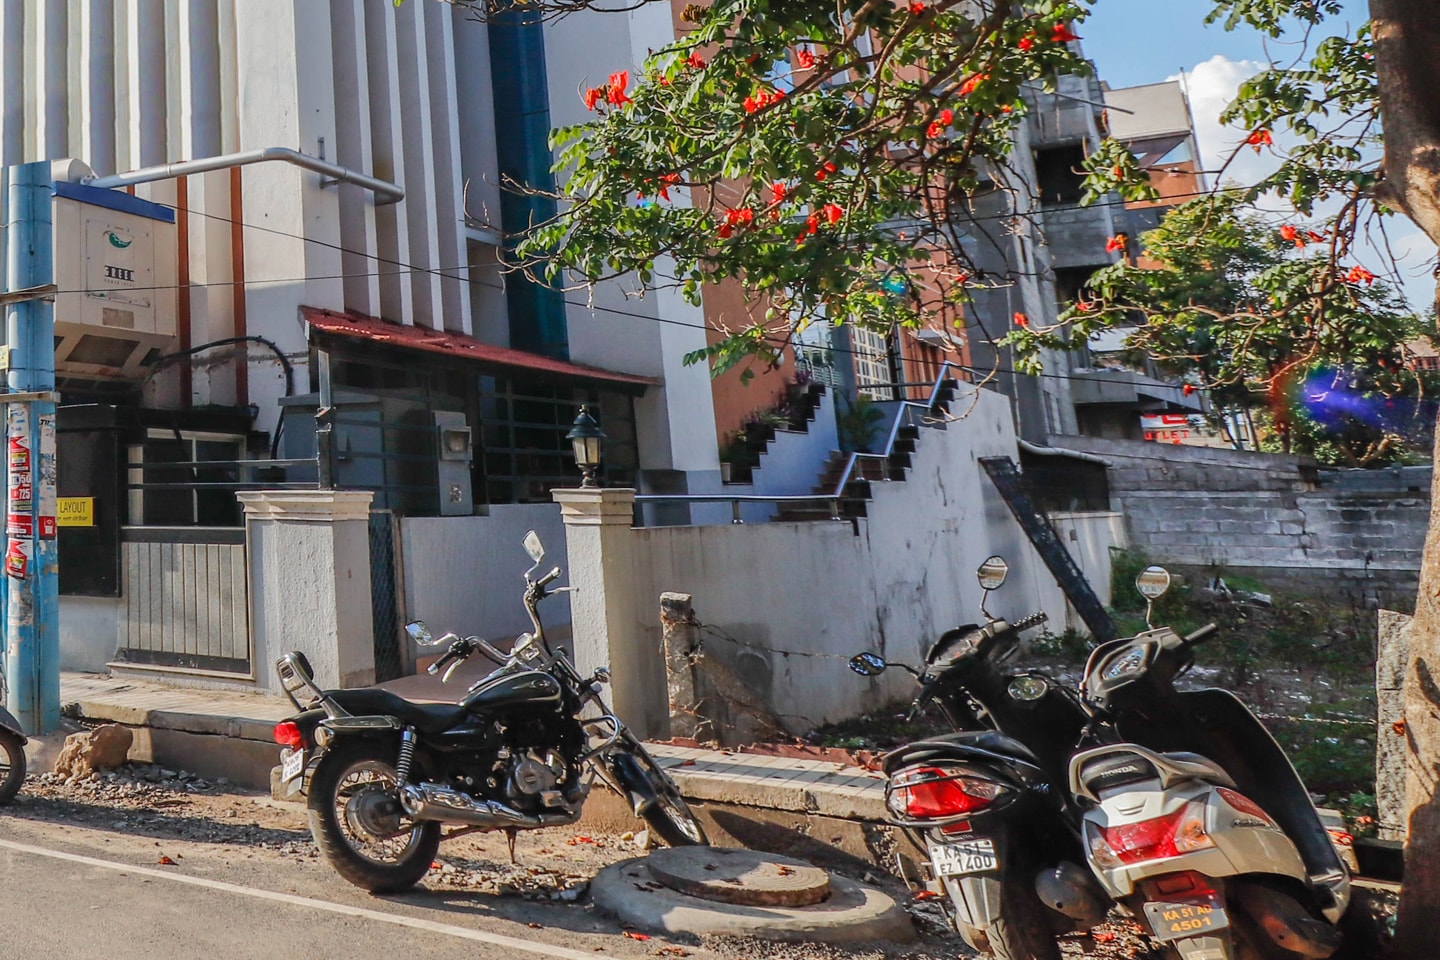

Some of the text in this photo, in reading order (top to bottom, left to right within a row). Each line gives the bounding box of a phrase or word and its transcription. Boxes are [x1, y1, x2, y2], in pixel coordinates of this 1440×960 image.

[104, 265, 135, 282] GREEN
[60, 501, 87, 513] LAYOUT
[1100, 765, 1139, 778] HONDA
[942, 844, 962, 860] KA
[940, 854, 992, 874] EZ 1400
[1162, 910, 1180, 921] KA
[1181, 907, 1194, 918] 51
[1170, 916, 1212, 932] 4501
